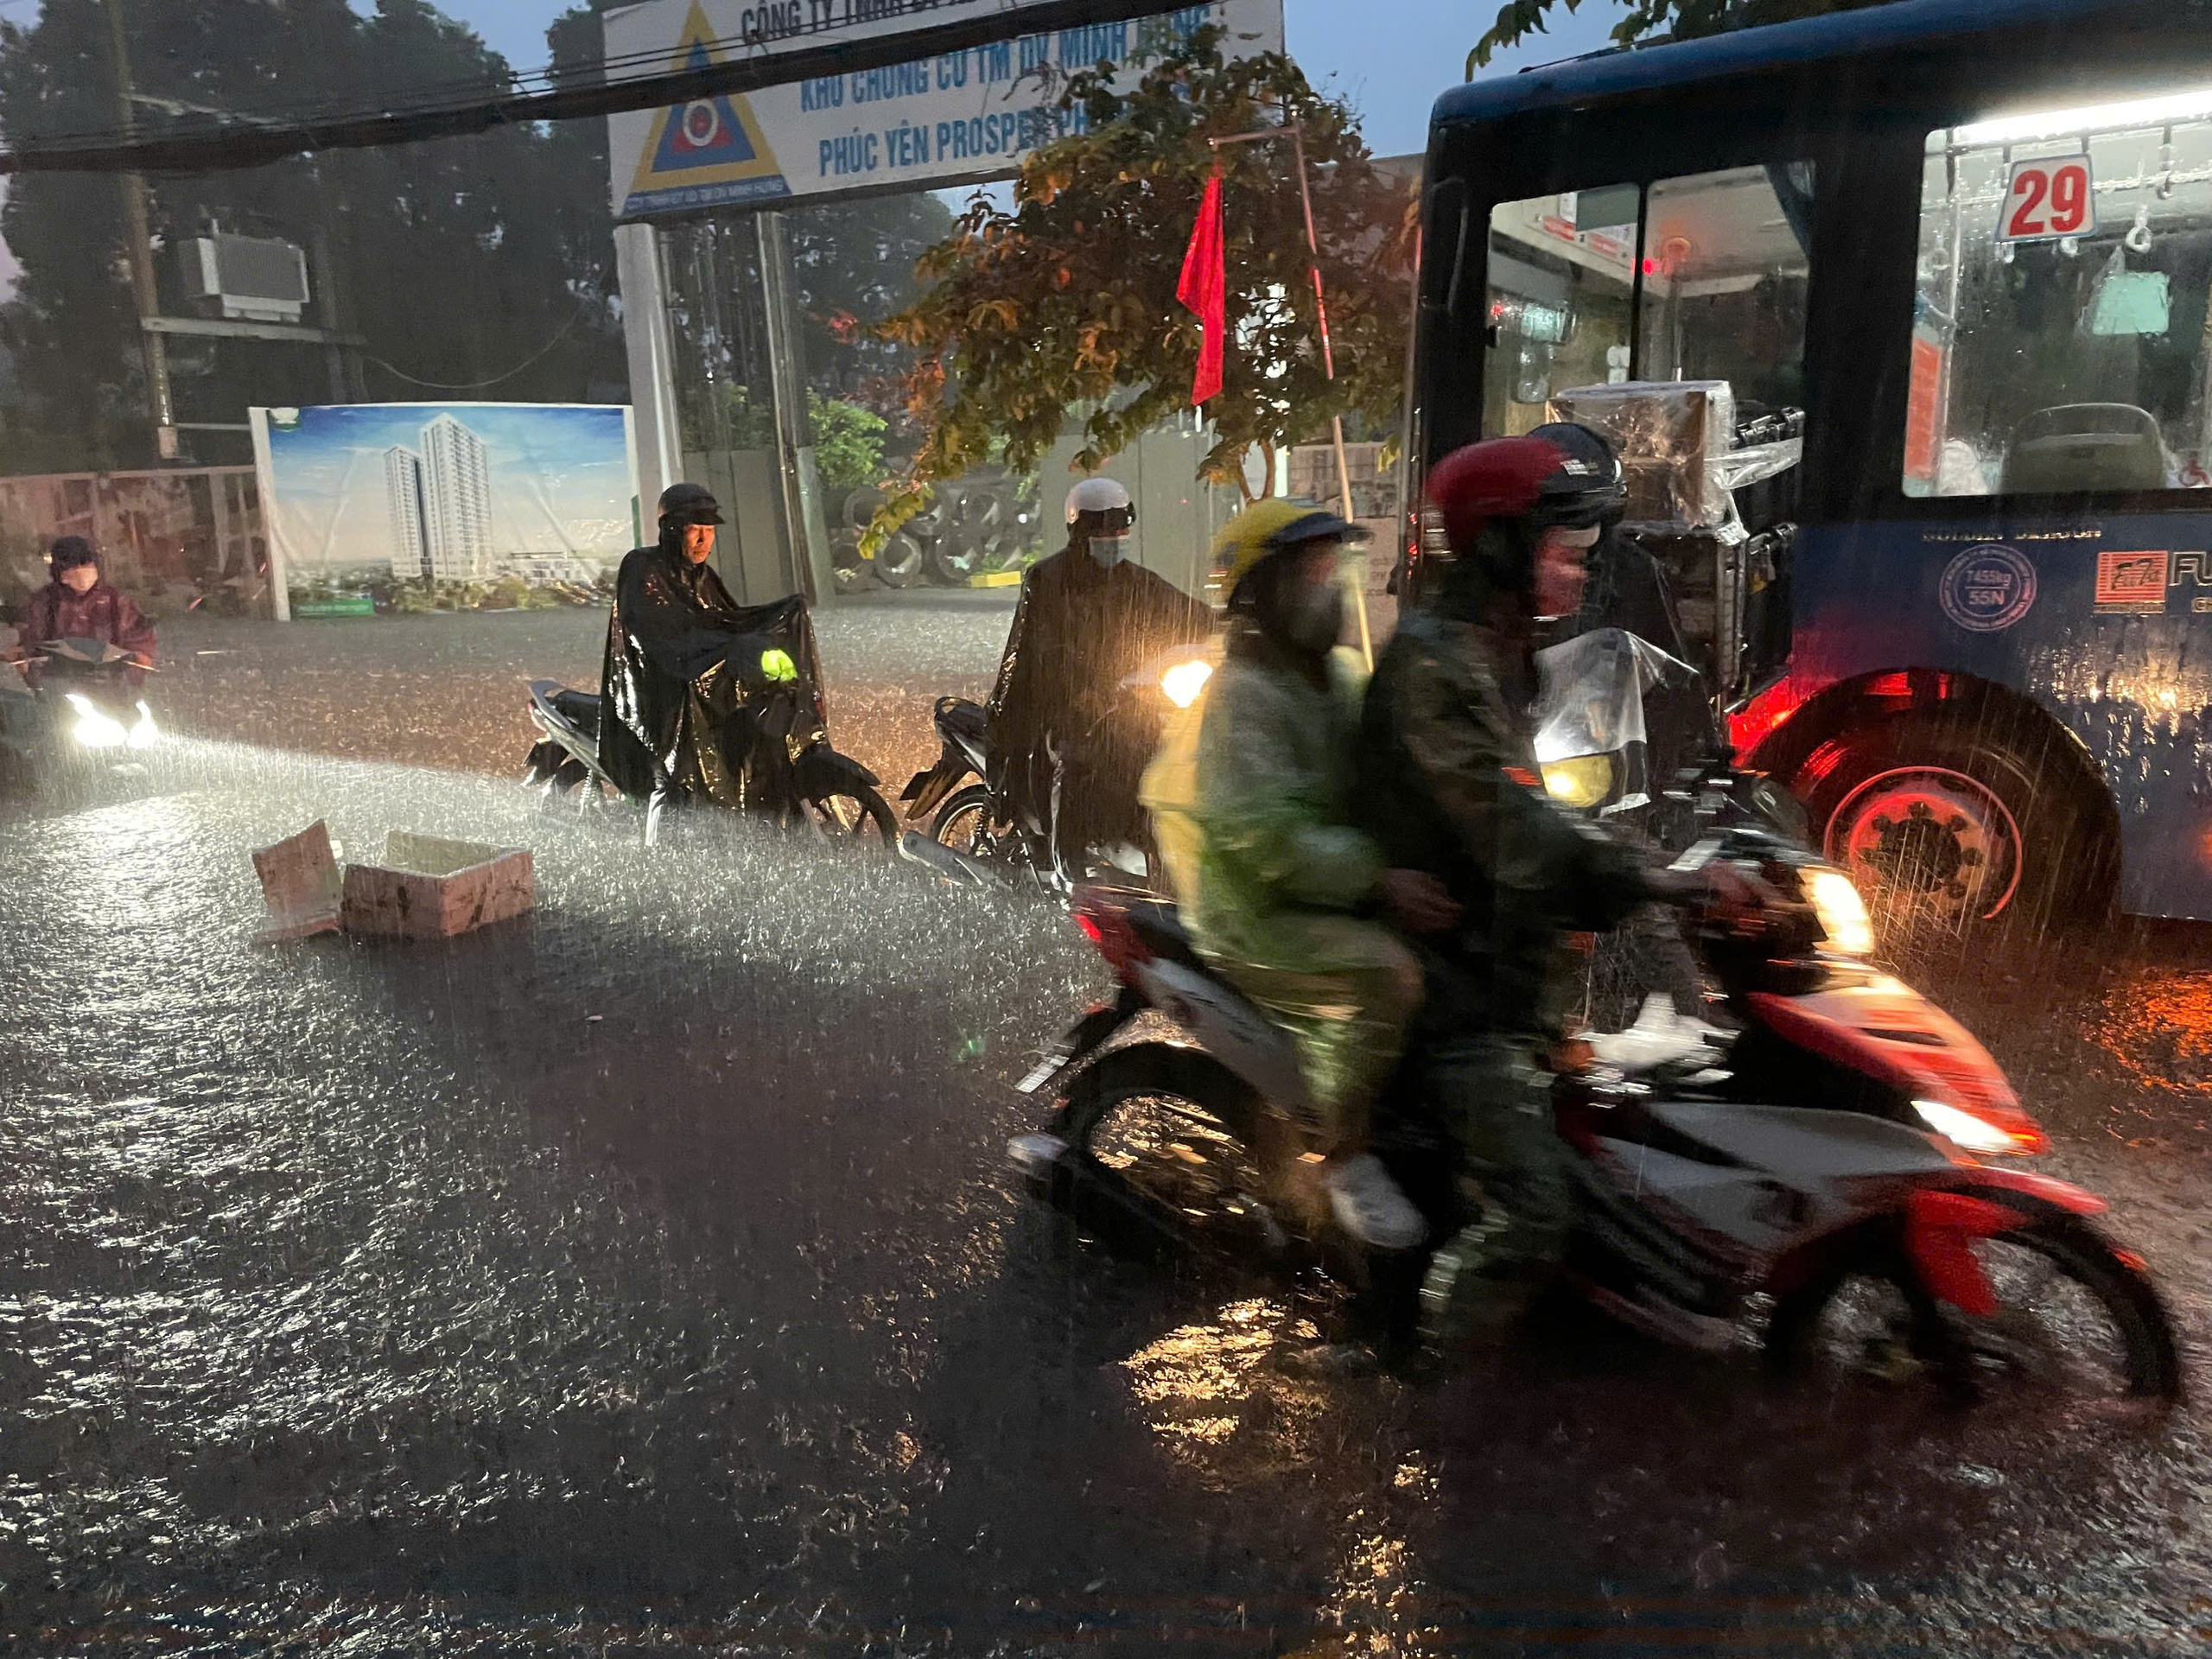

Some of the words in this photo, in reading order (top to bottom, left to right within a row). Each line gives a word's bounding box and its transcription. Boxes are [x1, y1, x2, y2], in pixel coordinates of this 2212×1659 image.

[851, 62, 929, 104] CHUNG
[1059, 21, 1127, 70] MINH
[819, 126, 878, 178] PHÚC
[885, 118, 929, 168] YÊN
[2009, 165, 2088, 236] 29
